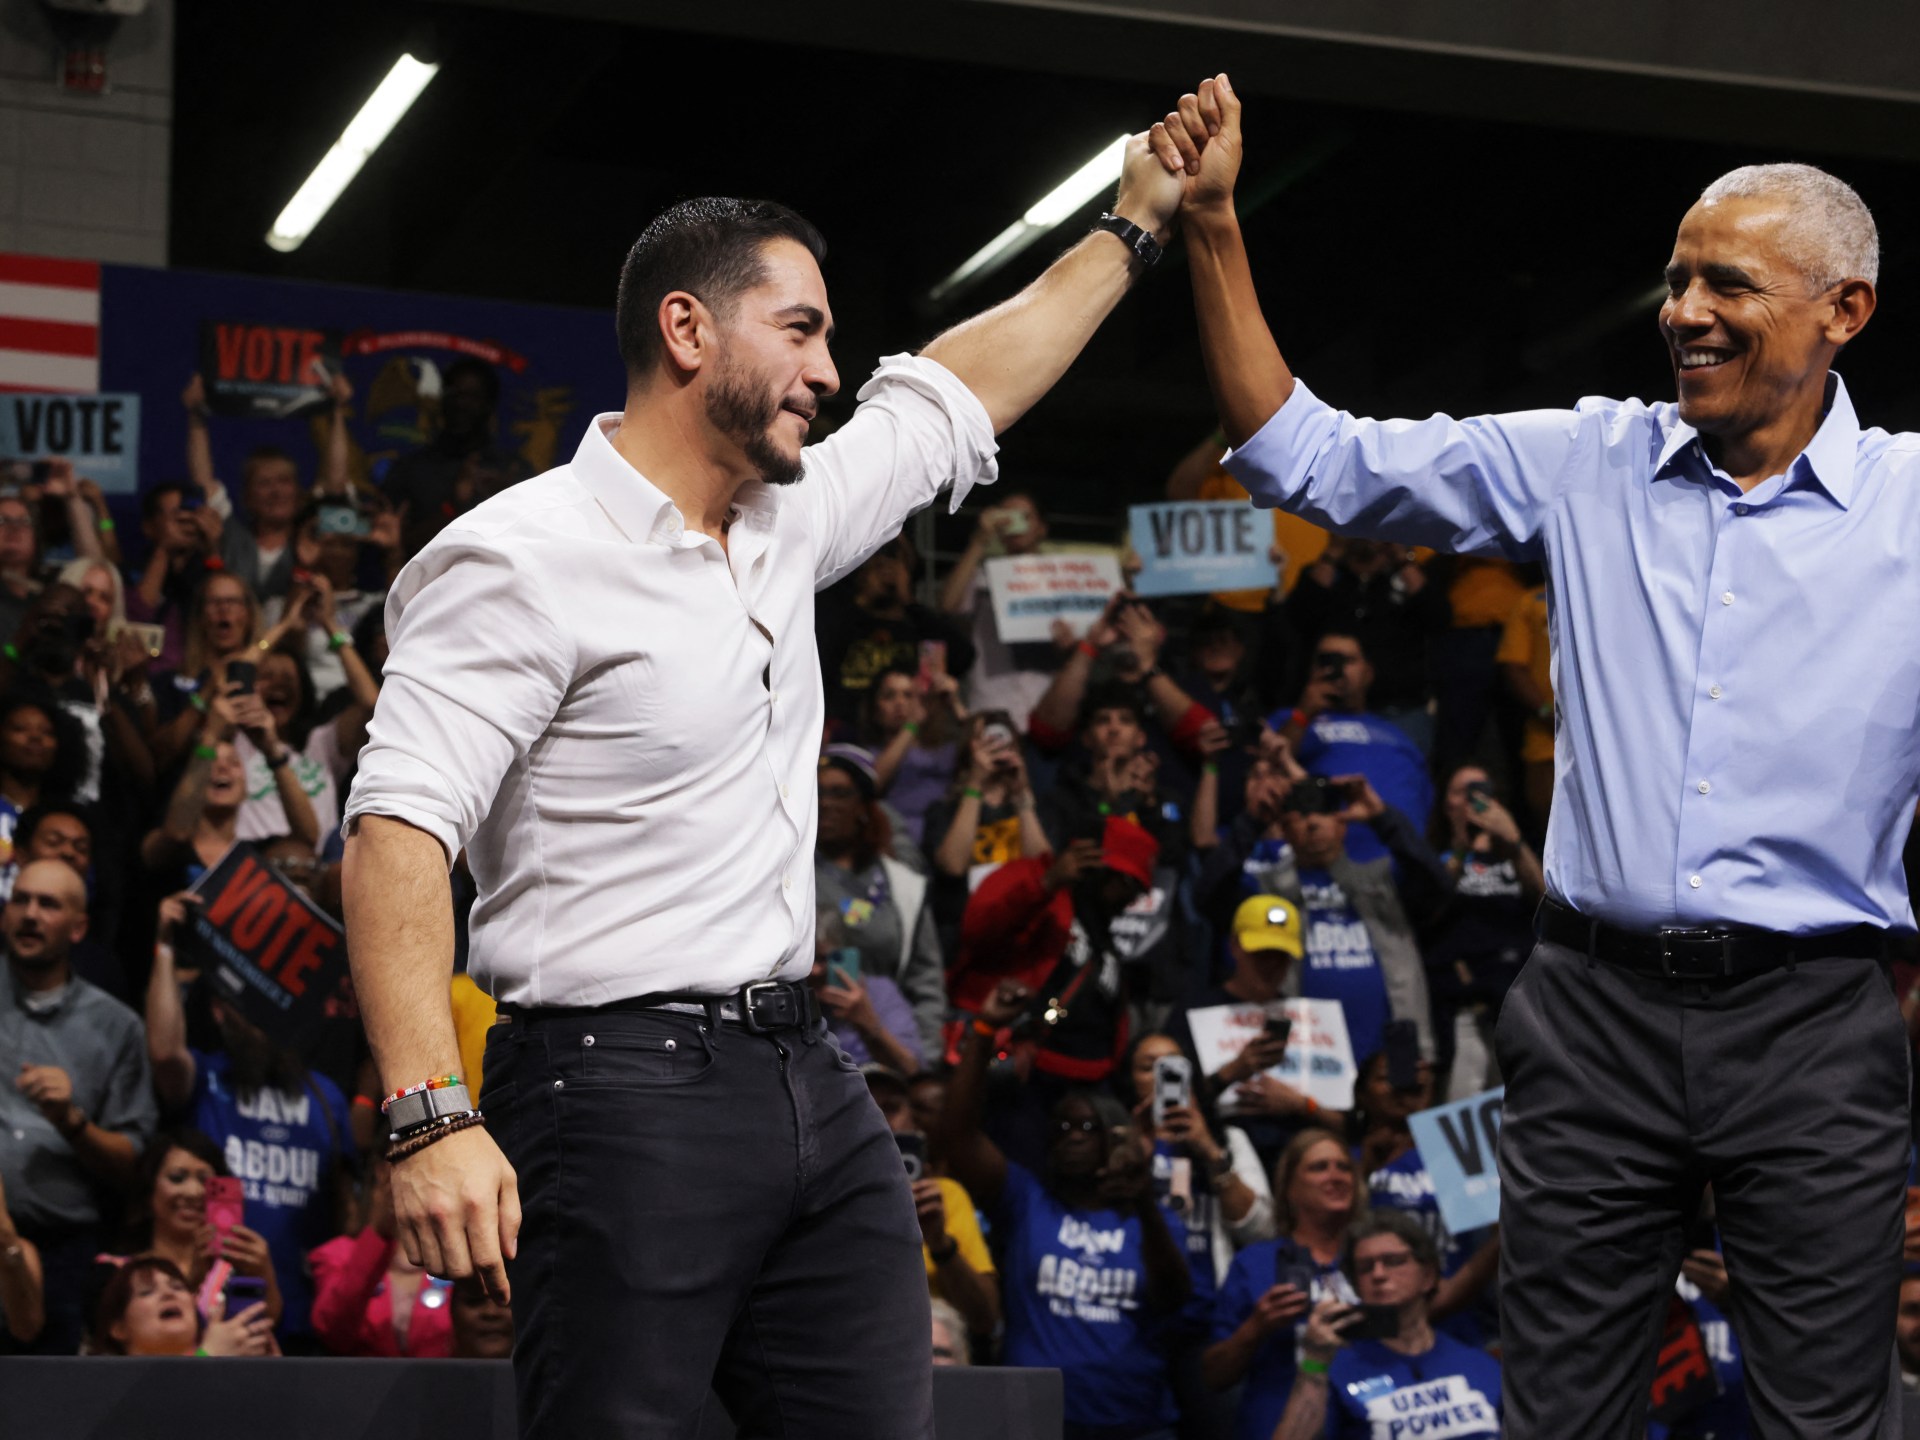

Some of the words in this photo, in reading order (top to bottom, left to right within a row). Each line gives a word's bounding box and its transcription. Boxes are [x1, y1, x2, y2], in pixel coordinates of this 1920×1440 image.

[215, 322, 326, 385] VOTE
[15, 398, 123, 454] VOTE
[1150, 508, 1255, 557] VOTE
[207, 856, 338, 998] VOTE
[1057, 1214, 1126, 1254] UAW
[1036, 1254, 1140, 1310] ABDUL
[1390, 1403, 1484, 1440] POWER
[1391, 1386, 1450, 1412] UAW
